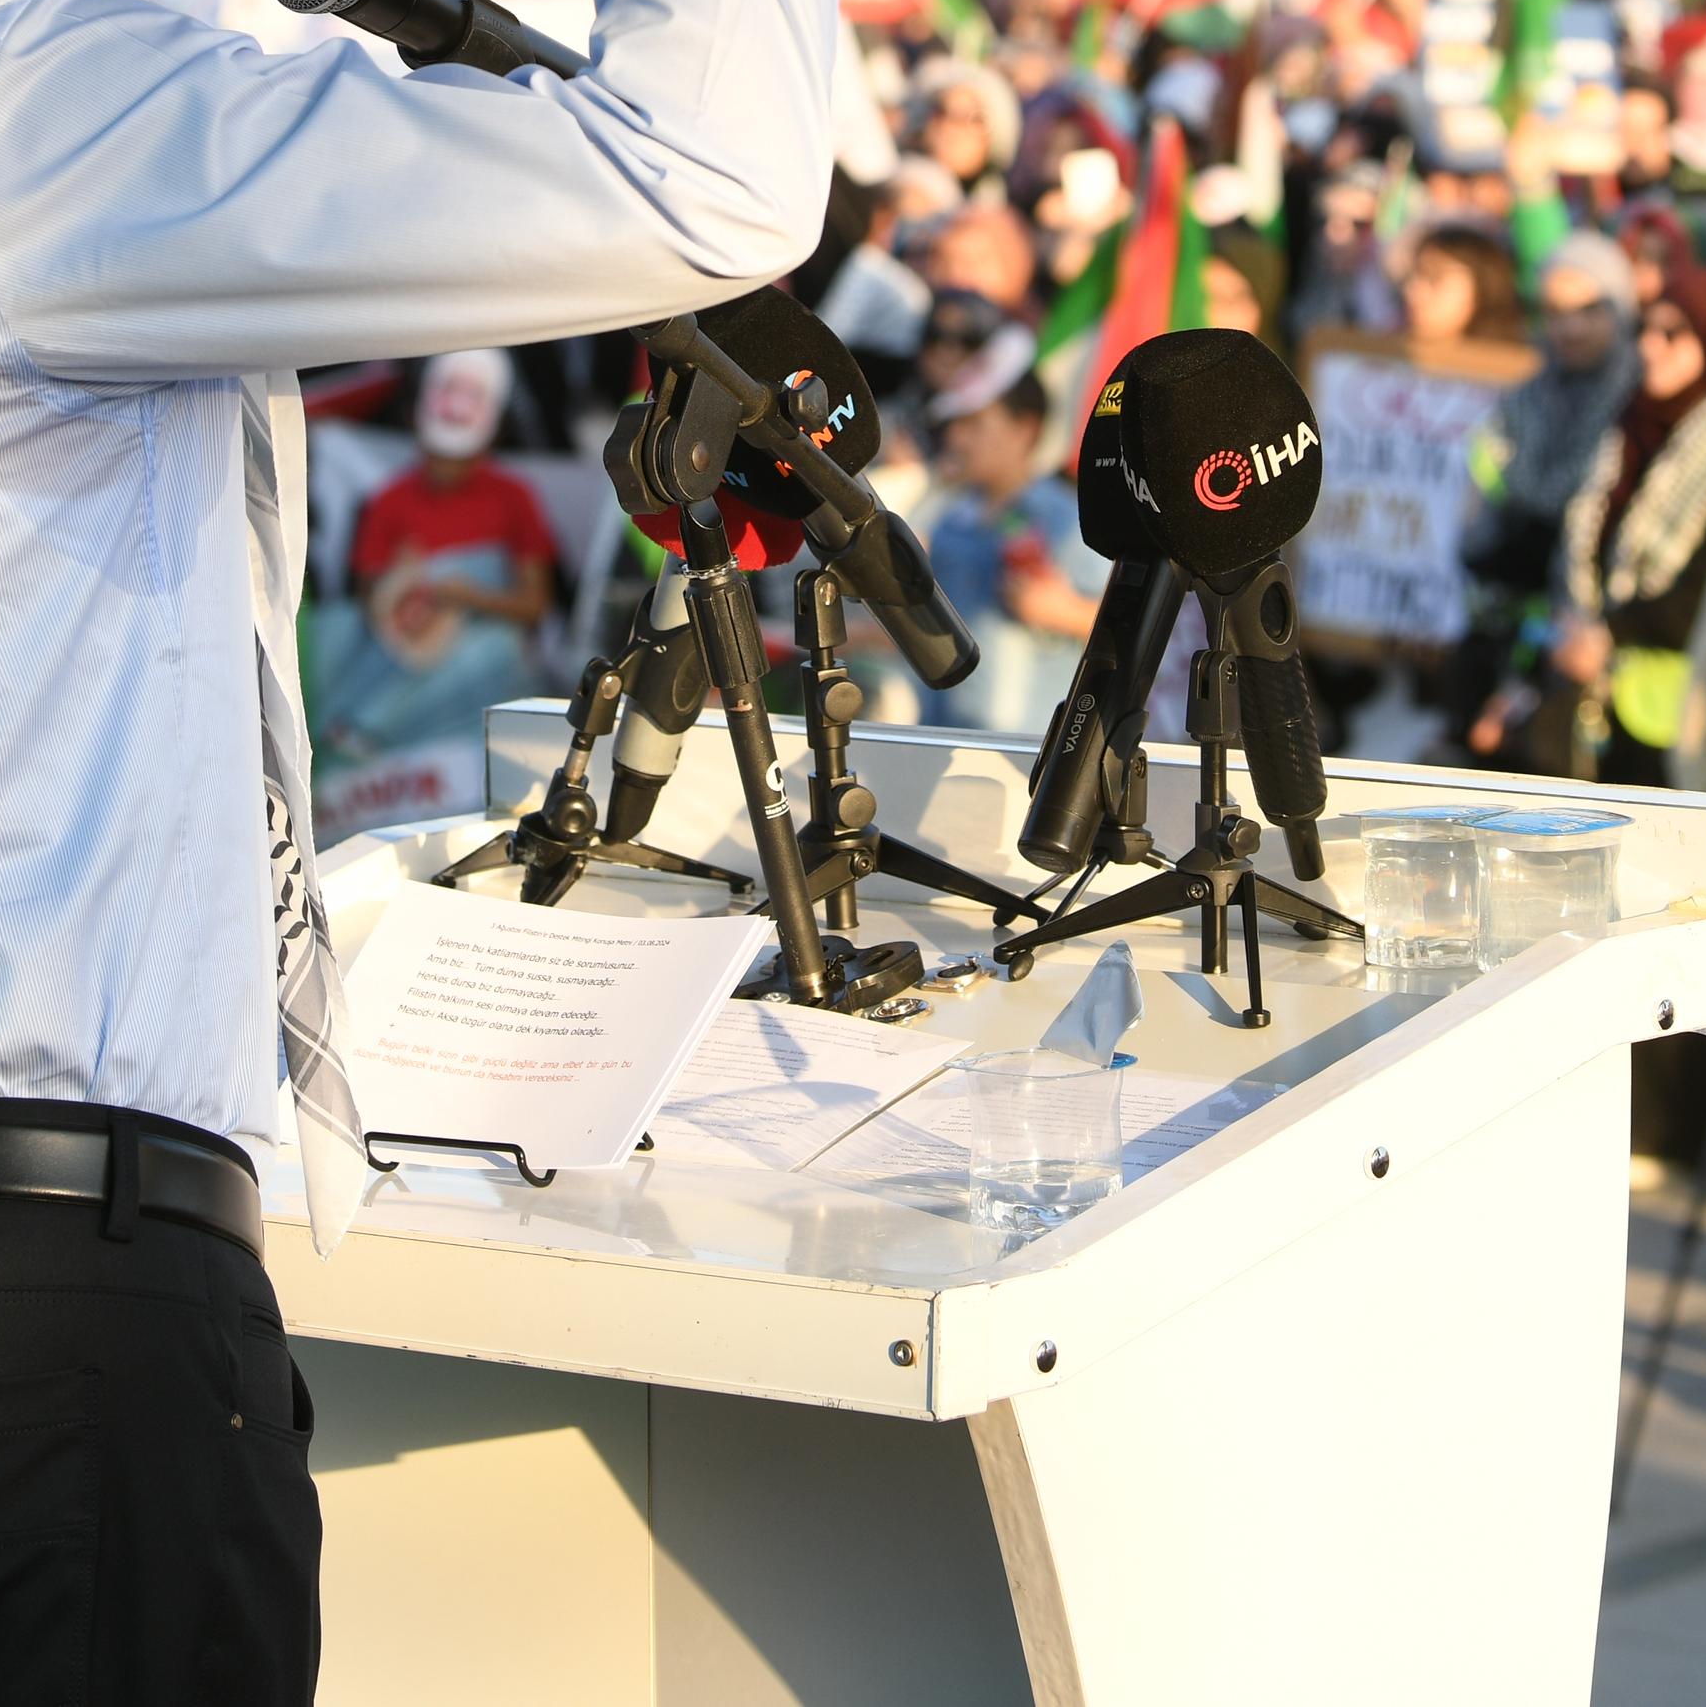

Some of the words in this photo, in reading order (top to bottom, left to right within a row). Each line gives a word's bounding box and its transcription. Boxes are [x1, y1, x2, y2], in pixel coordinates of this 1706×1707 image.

[1249, 420, 1321, 487] İHA
[1062, 712, 1087, 755] BOYA
[437, 935, 470, 950] İşlenen
[472, 943, 485, 953] bu
[487, 945, 548, 964] katliamlardan
[549, 955, 562, 966] siz
[563, 956, 575, 968] de
[417, 970, 449, 985] Herkes
[451, 976, 477, 989] dursa
[479, 980, 493, 991] biz
[427, 953, 448, 966] Ama
[475, 962, 495, 974] Tüm
[497, 965, 525, 979] dünya
[527, 971, 554, 984] sussa,
[408, 986, 437, 1001] Filistin
[439, 992, 474, 1008] halkının
[477, 999, 494, 1011] sesi
[495, 1004, 529, 1017] olmaya
[530, 1007, 560, 1019] devam
[397, 1003, 435, 1019] Mescid-i
[437, 1011, 459, 1024] Aksa
[460, 1015, 487, 1029] özgür
[489, 1020, 514, 1033] olana
[516, 1024, 533, 1035] dek
[533, 1026, 570, 1038] kıyamda
[377, 1036, 409, 1052] Bugün
[412, 1044, 435, 1056] belki
[462, 1052, 480, 1065] gibi
[482, 1056, 508, 1069] güçlü
[541, 1061, 560, 1070] ama
[563, 1059, 584, 1070] elbet
[586, 1059, 599, 1069] bir
[601, 1059, 619, 1071] gün
[621, 1059, 634, 1069] bu
[474, 1068, 486, 1079] da
